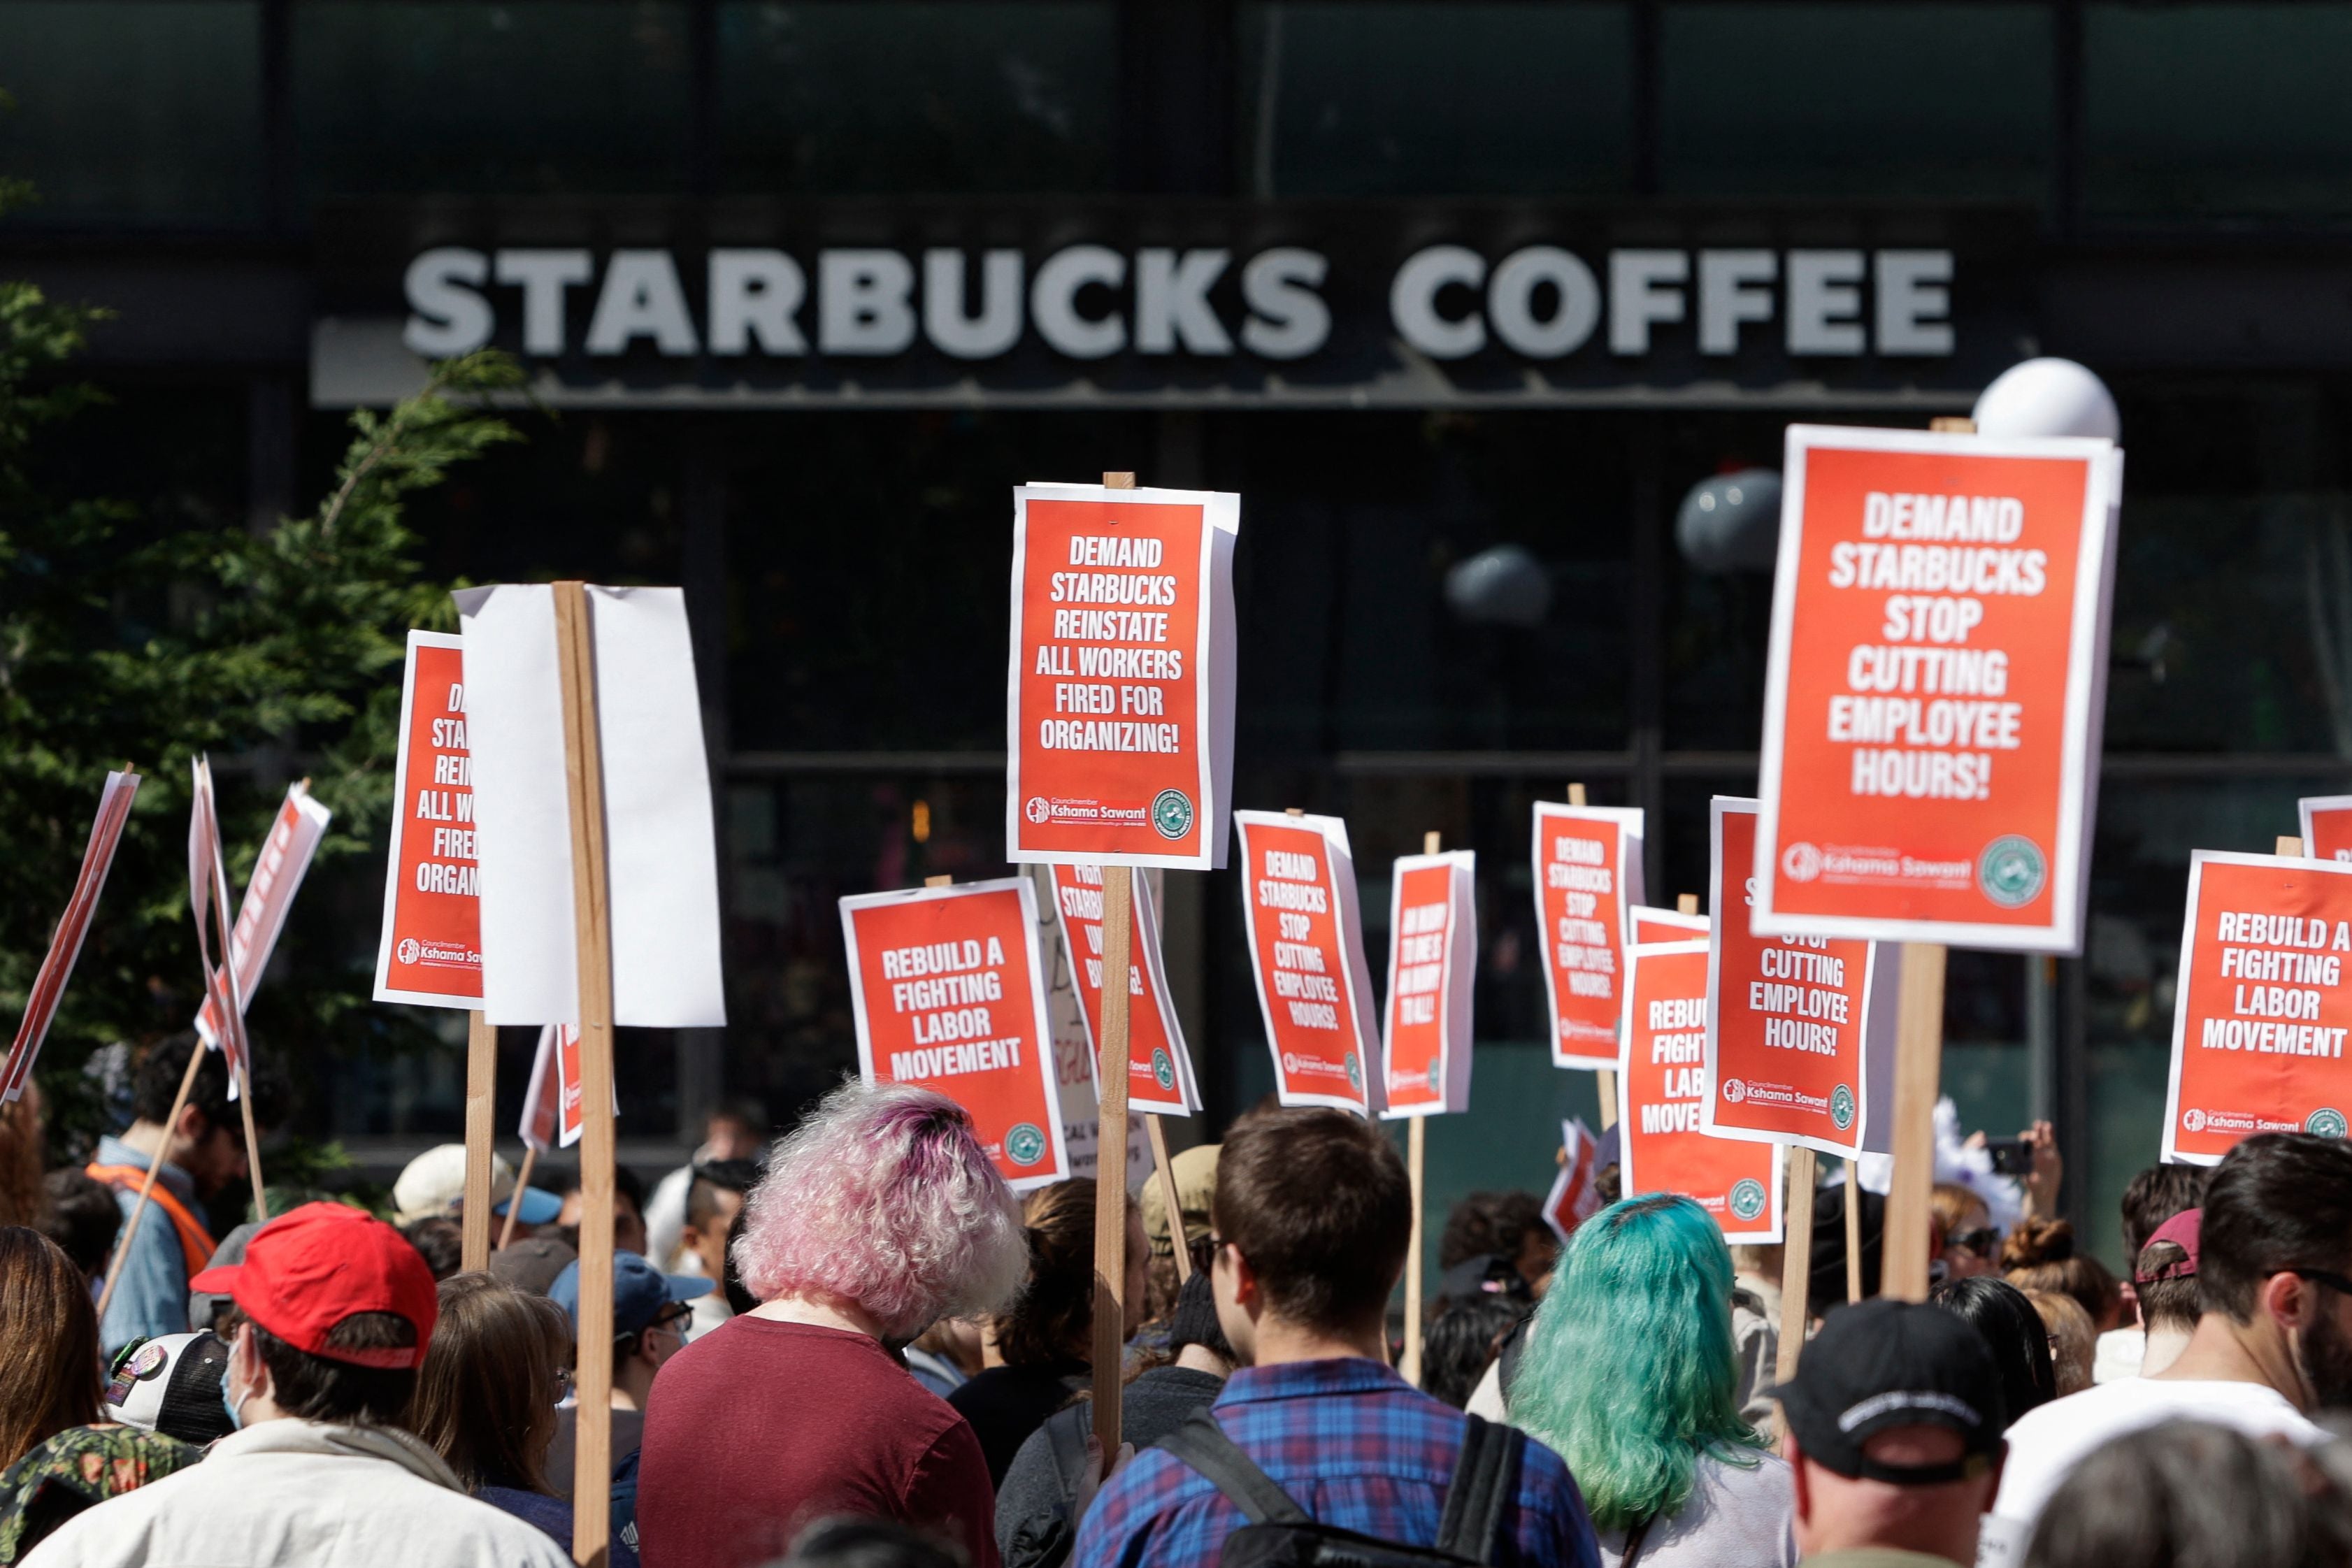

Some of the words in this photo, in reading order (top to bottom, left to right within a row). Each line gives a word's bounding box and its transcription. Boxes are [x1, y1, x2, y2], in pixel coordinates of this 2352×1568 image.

[403, 245, 1331, 359] STARBUCKS
[1389, 245, 1954, 359] COFFEE
[1862, 491, 2023, 543] DEMAND
[1069, 535, 1162, 568] DEMAND
[1828, 542, 2047, 596] STARBUCKS
[1050, 571, 1176, 606] STARBUCKS
[1054, 609, 1168, 642] REINSTATE
[1882, 595, 1983, 644] STOP
[1035, 645, 1075, 675] ALL
[1078, 647, 1183, 680] WORKERS
[1847, 645, 2008, 697] CUTTING
[1055, 682, 1116, 714] FIRED
[1121, 686, 1163, 716] FOR
[1040, 719, 1180, 754] ORGANIZING!
[1827, 696, 2023, 749] EMPLOYEE
[1851, 749, 1991, 800] HOURS!
[417, 789, 452, 821] ALL
[1051, 805, 1098, 818] Kshama
[1100, 806, 1146, 819] Sawant
[1265, 850, 1317, 882] DEMAND
[1259, 879, 1327, 914] STARBUCKS
[1279, 912, 1310, 941] STOP
[2218, 911, 2327, 949] REBUILD
[2331, 921, 2351, 951] A
[420, 946, 464, 961] Kshama
[882, 939, 982, 979] REBUILD
[987, 937, 1005, 966] A
[1274, 940, 1326, 972] CUTTING
[1761, 947, 1844, 988] CUTTING
[2221, 947, 2341, 986] FIGHTING
[892, 971, 1003, 1013] FIGHTING
[1272, 970, 1339, 1002] EMPLOYEE
[1749, 981, 1849, 1024] EMPLOYEE
[2235, 984, 2321, 1021] LABOR
[912, 1007, 992, 1045] LABOR
[1288, 1000, 1339, 1030] HOURS!
[1765, 1017, 1837, 1056] HOURS!
[2202, 1018, 2349, 1058] MOVEMENT
[890, 1037, 1021, 1081] MOVEMENT
[1747, 1086, 1793, 1102] Kshama
[1795, 1092, 1828, 1108] Sawant
[2207, 1116, 2254, 1129] Kshama
[2256, 1119, 2300, 1132] Sawant
